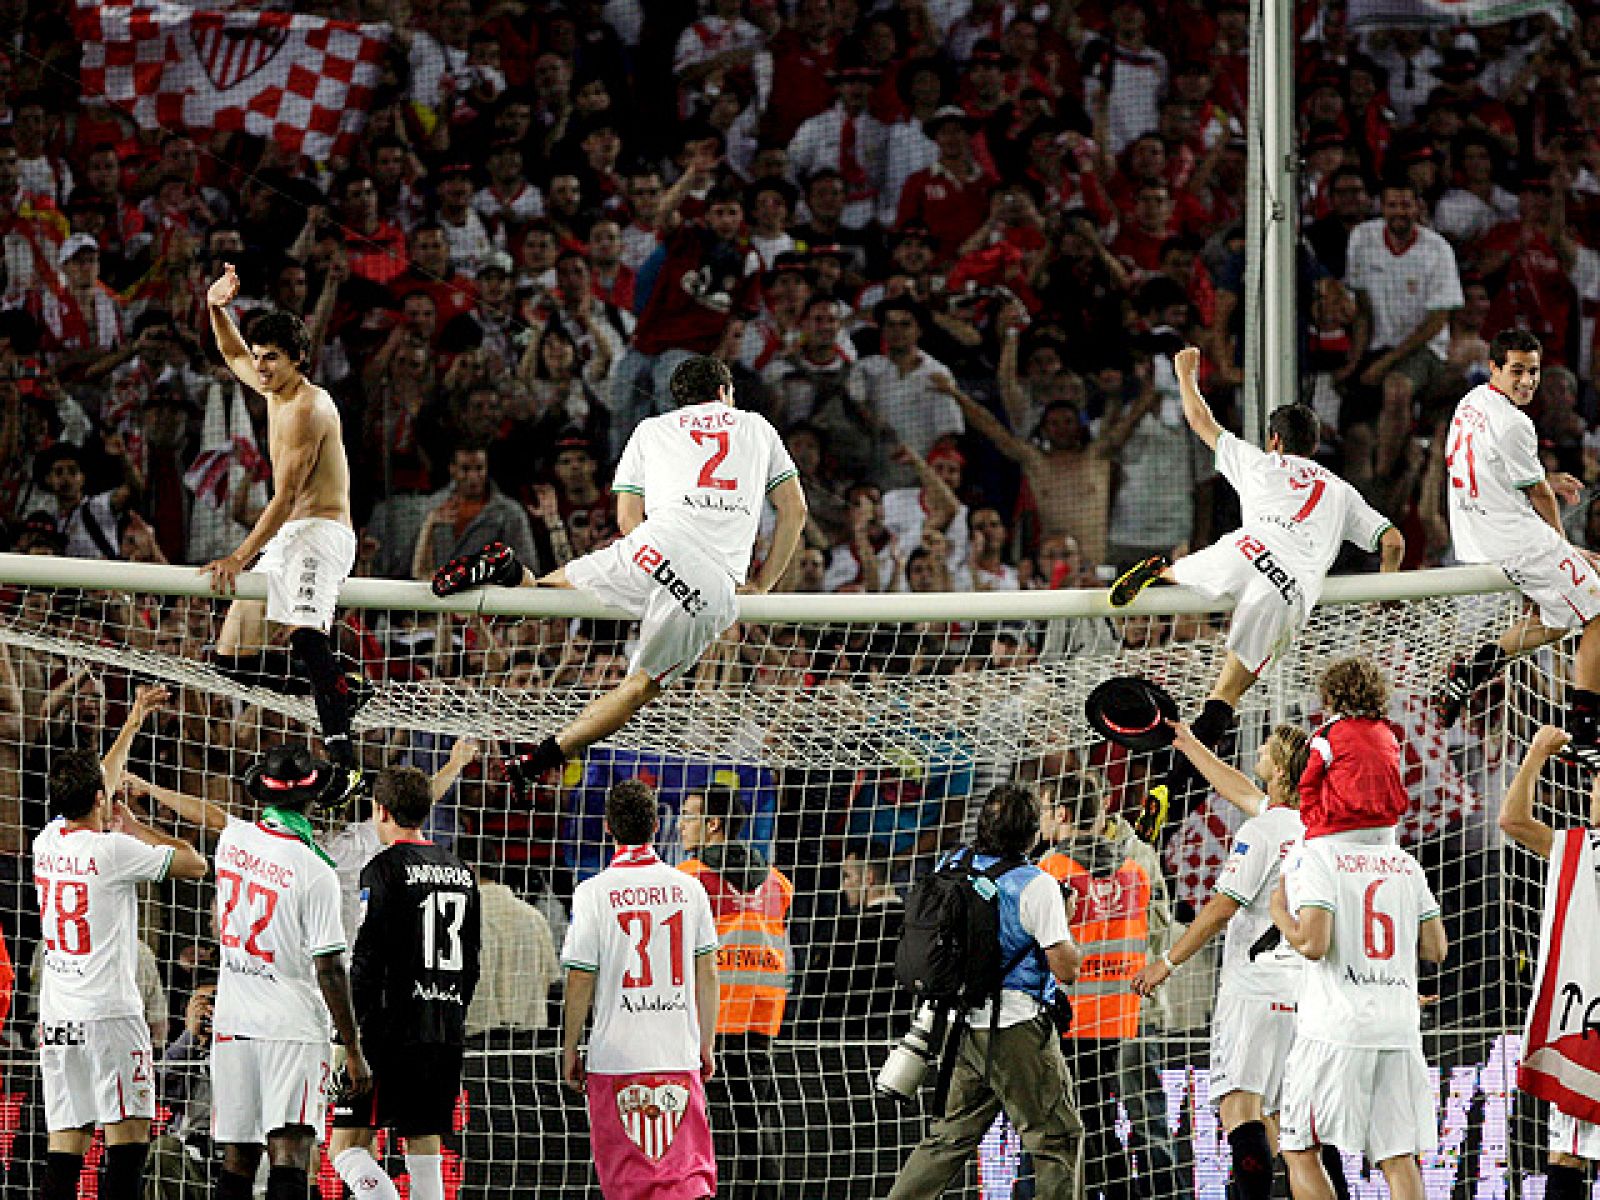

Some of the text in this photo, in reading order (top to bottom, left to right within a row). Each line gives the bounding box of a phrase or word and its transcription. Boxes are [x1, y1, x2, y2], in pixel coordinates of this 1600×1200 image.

[690, 430, 737, 490] 2
[1289, 477, 1326, 522] 7
[33, 875, 92, 955] 28
[216, 868, 279, 964] 22
[418, 891, 468, 971] 13
[609, 886, 667, 908] RODRI
[1363, 877, 1396, 961] 6
[616, 909, 684, 988] 31
